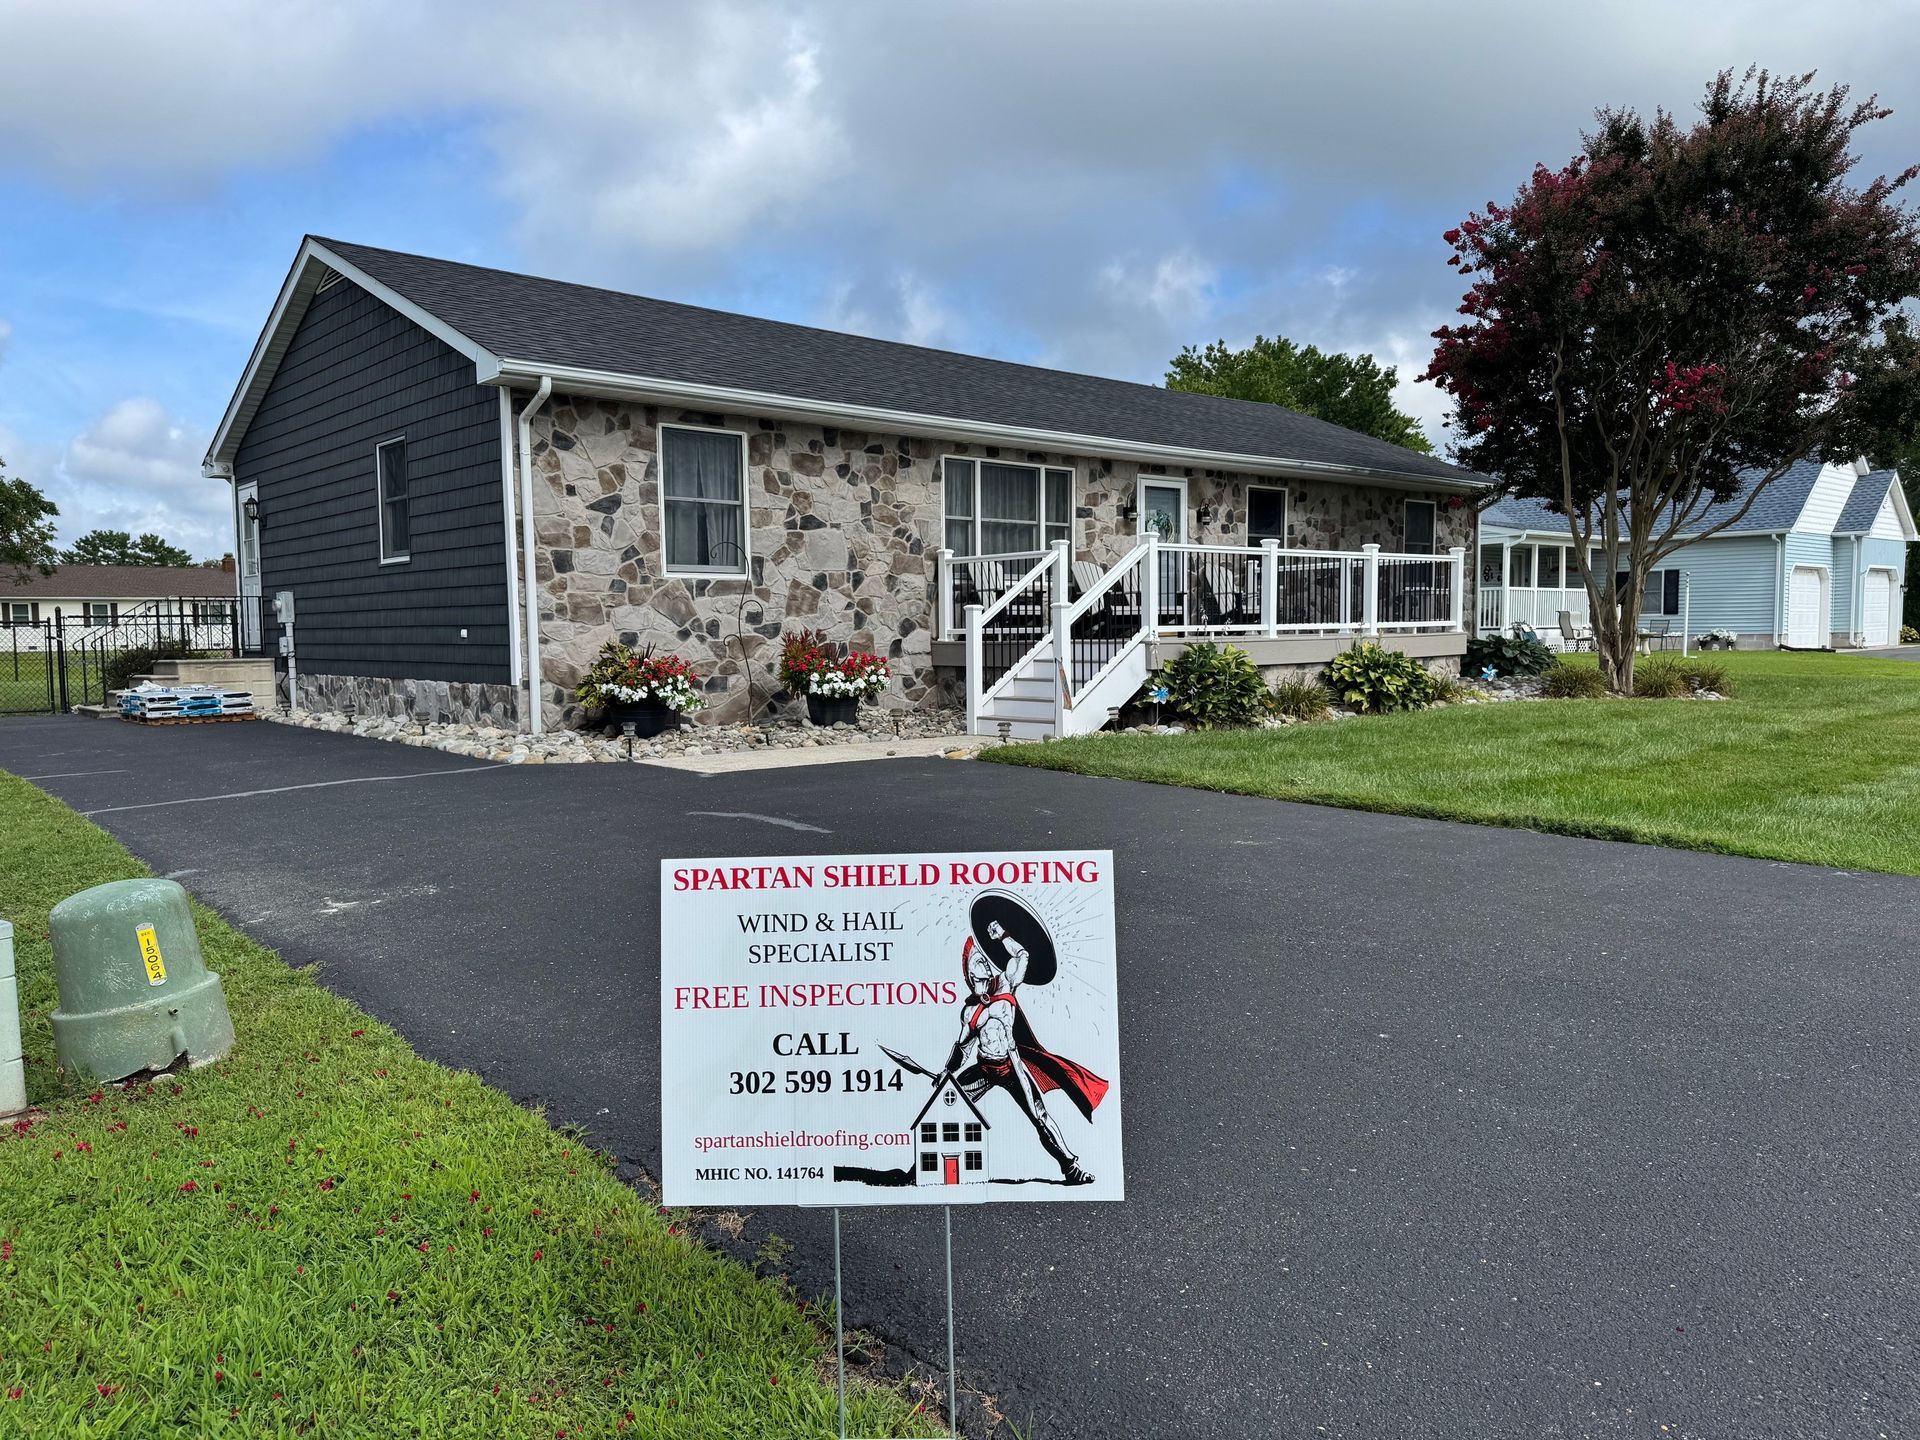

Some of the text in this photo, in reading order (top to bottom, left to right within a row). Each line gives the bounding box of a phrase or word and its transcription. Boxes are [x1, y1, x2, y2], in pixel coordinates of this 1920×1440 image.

[673, 860, 1100, 891] SPARTAN SHIELD ROOFING
[737, 911, 904, 933] WIND & HAIL
[146, 938, 163, 979] 15064
[748, 942, 894, 964] SPECIALIST
[674, 981, 957, 1010] FREE INSPECTIONS
[772, 1032, 859, 1056] CALL
[729, 1068, 904, 1095] 302 599 1914
[694, 1129, 911, 1153] spartanshieldroofing.com
[695, 1166, 825, 1181] MHIC NO. 141764
